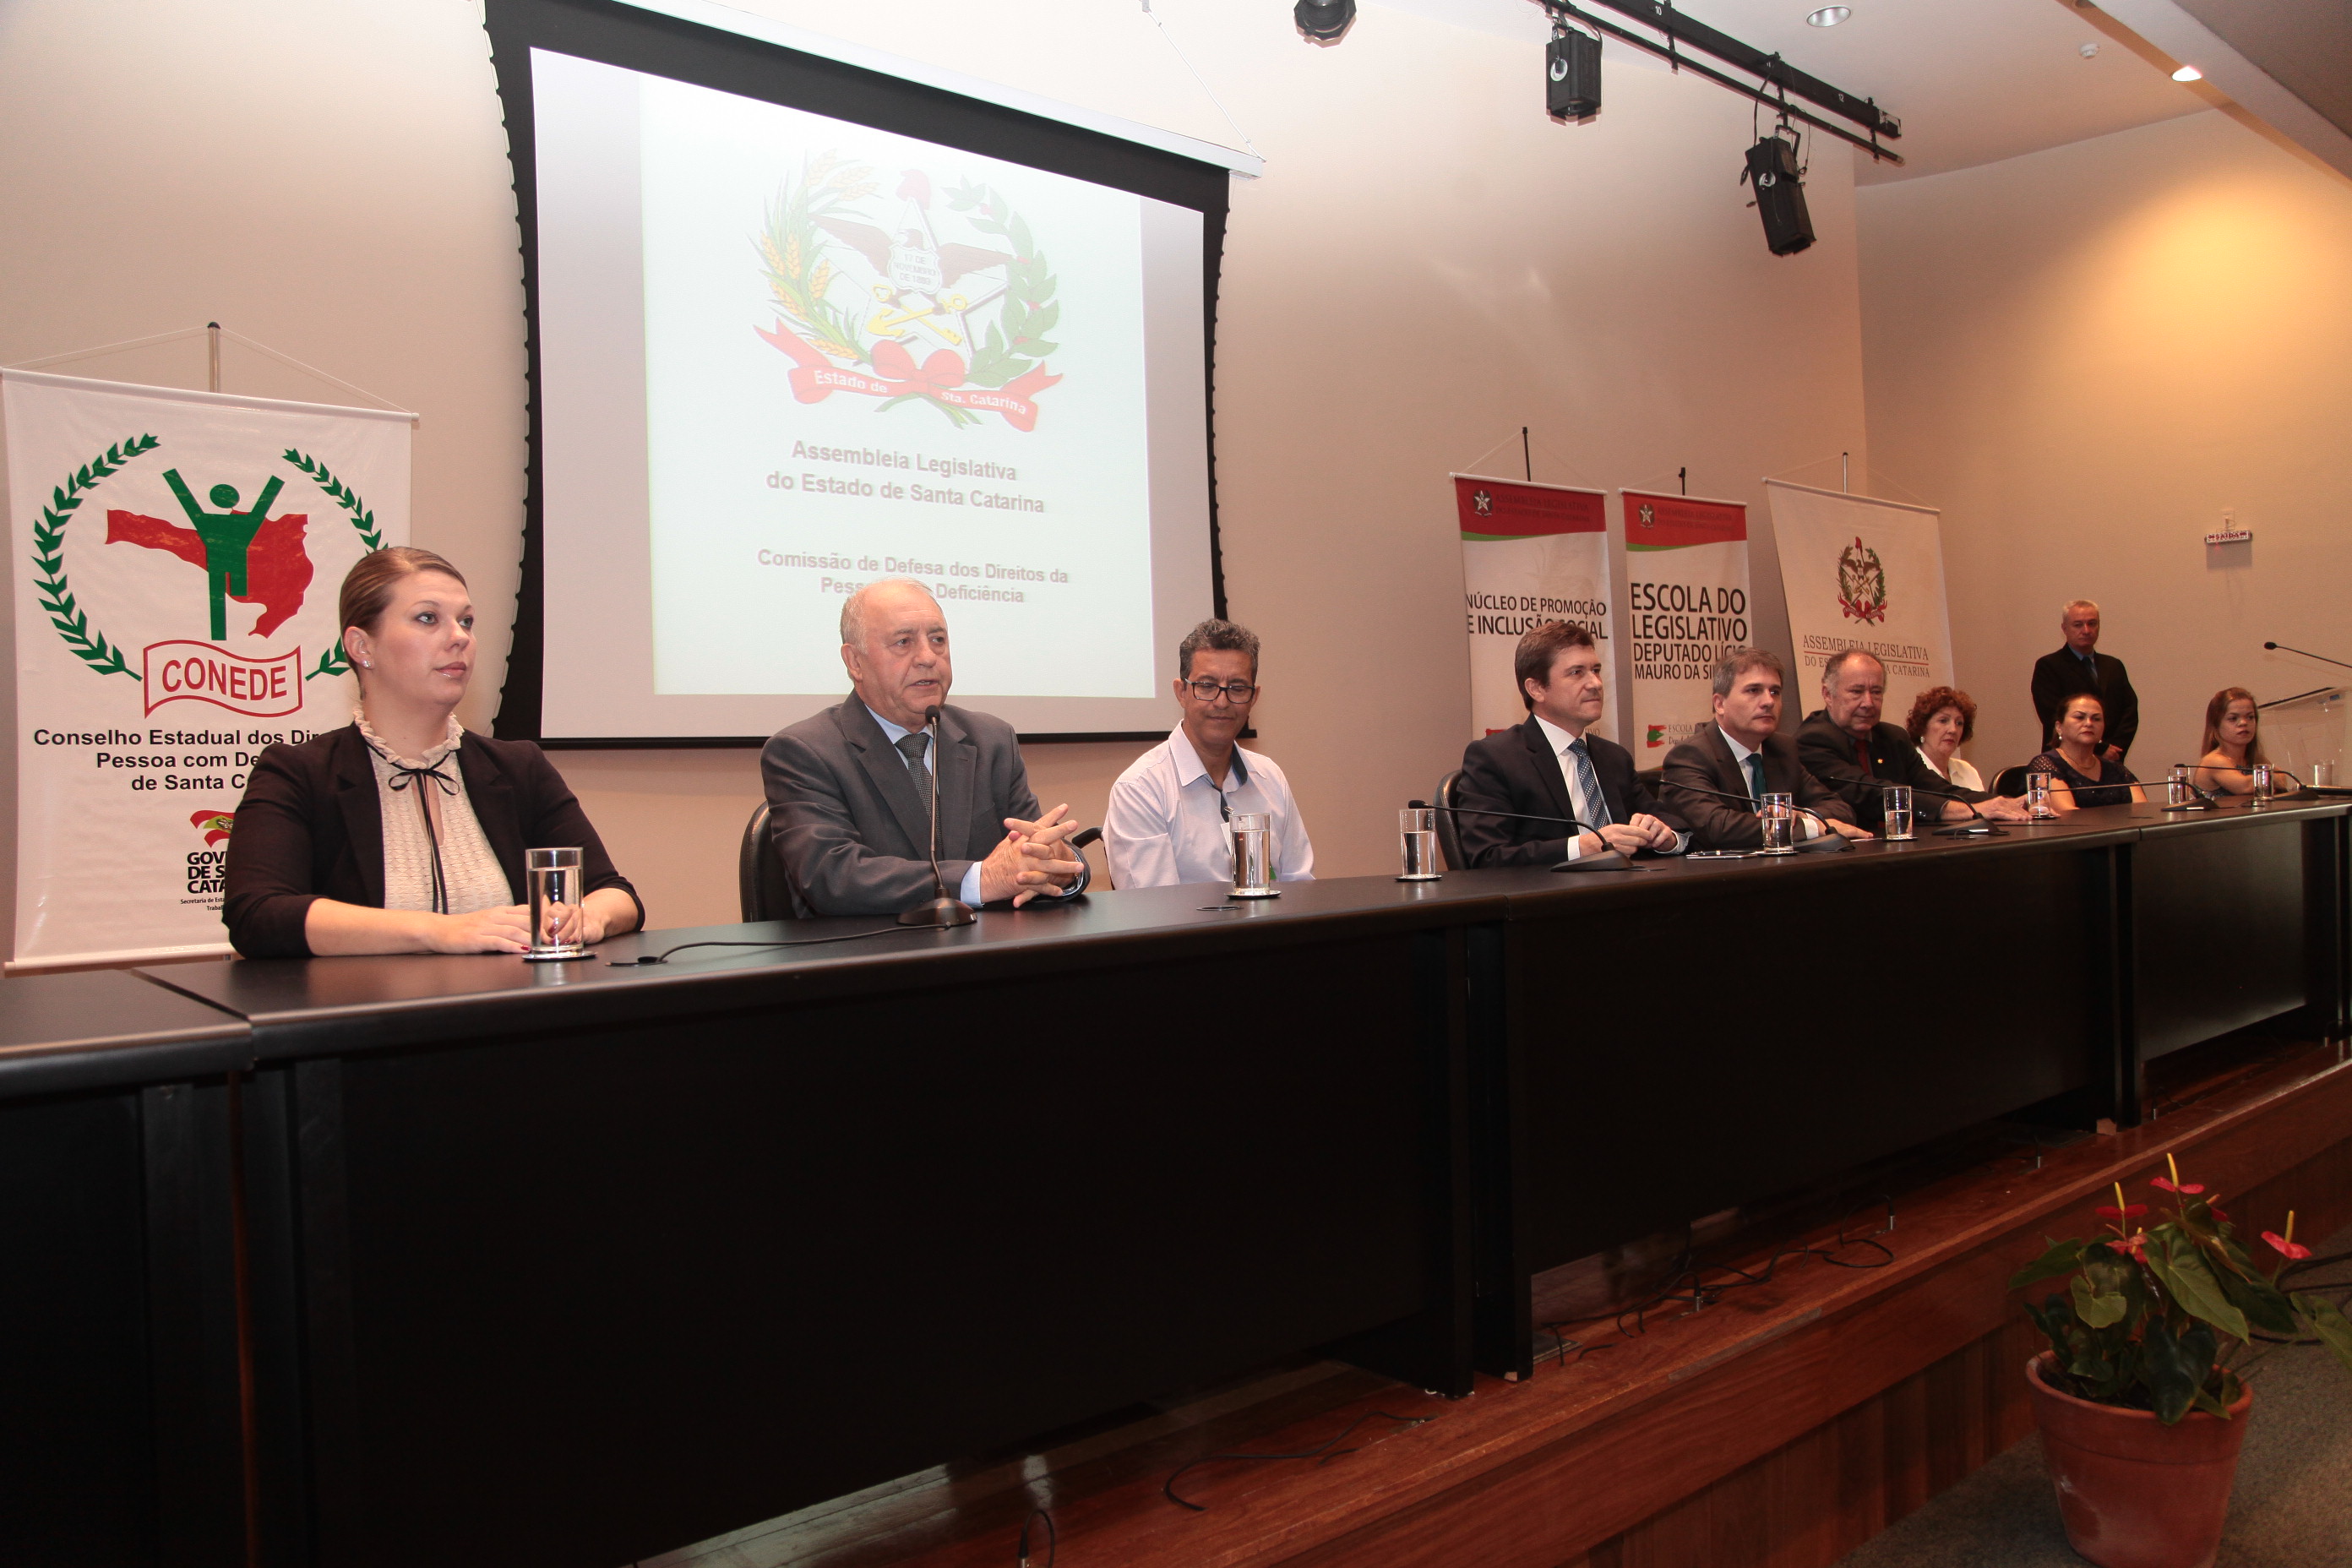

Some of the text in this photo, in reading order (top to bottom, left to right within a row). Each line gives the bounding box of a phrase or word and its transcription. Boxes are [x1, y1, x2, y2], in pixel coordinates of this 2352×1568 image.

[1655, 6, 1662, 15] 10
[814, 370, 888, 393] Estado de
[970, 395, 1026, 415] Catarina
[791, 440, 1016, 481] Assembleia Legislativa
[766, 471, 1044, 513] do Estado de Santa Catarina
[758, 549, 1068, 583] Comissão de Defesa dos Direitos da
[820, 576, 1024, 602] Pess Deficiência
[1467, 591, 1607, 618] NÚCLEO DE PROMOÇÃO
[1631, 583, 1745, 615] ESCOLA DO
[1468, 615, 1474, 634] E
[1632, 614, 1747, 642] LEGISLATIVO
[1634, 643, 1712, 662] DEPUTADO
[1868, 642, 1929, 661] LEGISLATIVA
[1805, 656, 1816, 667] DO
[162, 657, 287, 700] CONEDE
[1635, 664, 1680, 679] MAURO
[1684, 664, 1700, 679] DA
[1892, 665, 1930, 678] CATARINA
[34, 729, 142, 745] Conselho
[150, 729, 241, 745] Estadual
[248, 730, 284, 745] dos
[1669, 724, 1693, 732] ESCOLA
[97, 753, 176, 768] Pessoa
[183, 754, 227, 767] com
[132, 776, 157, 790] de
[165, 775, 224, 790] Santa
[188, 866, 211, 879] DE
[188, 879, 226, 894] CATA
